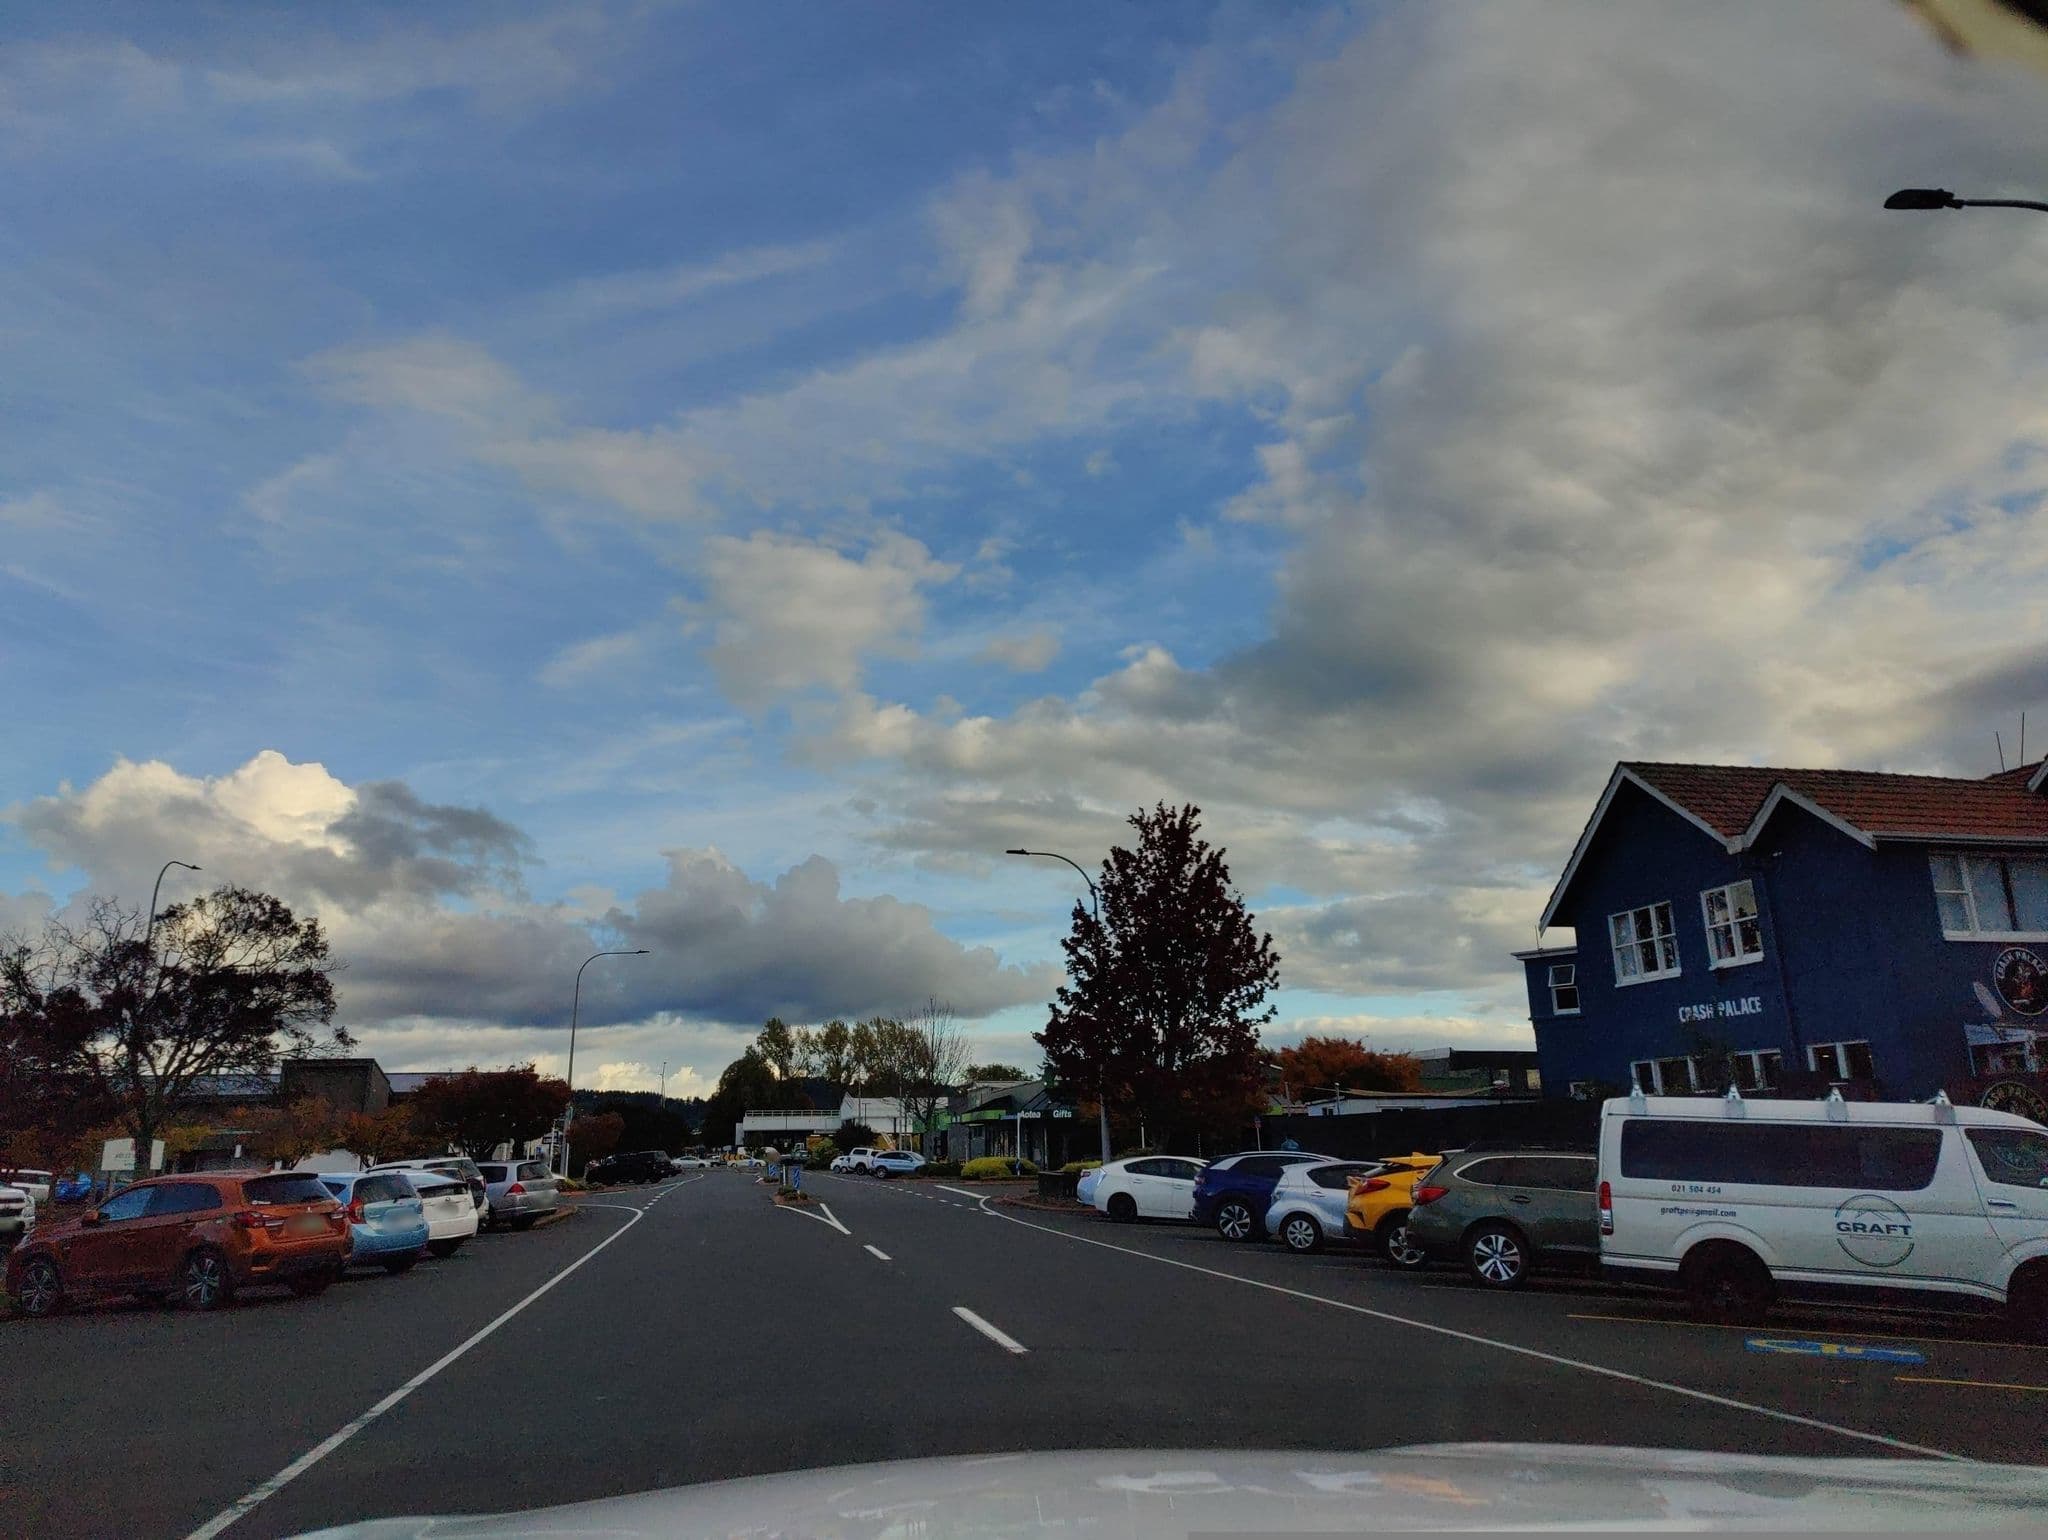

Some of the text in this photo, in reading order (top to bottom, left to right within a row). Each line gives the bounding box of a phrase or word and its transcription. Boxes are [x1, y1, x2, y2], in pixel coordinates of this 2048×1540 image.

[1678, 996, 1762, 1022] CRASH PALACE
[1019, 1110, 1041, 1119] Aotea
[1052, 1109, 1073, 1119] Gifts
[1671, 1184, 1686, 1193] 021
[1836, 1222, 1911, 1235] GRAFT
